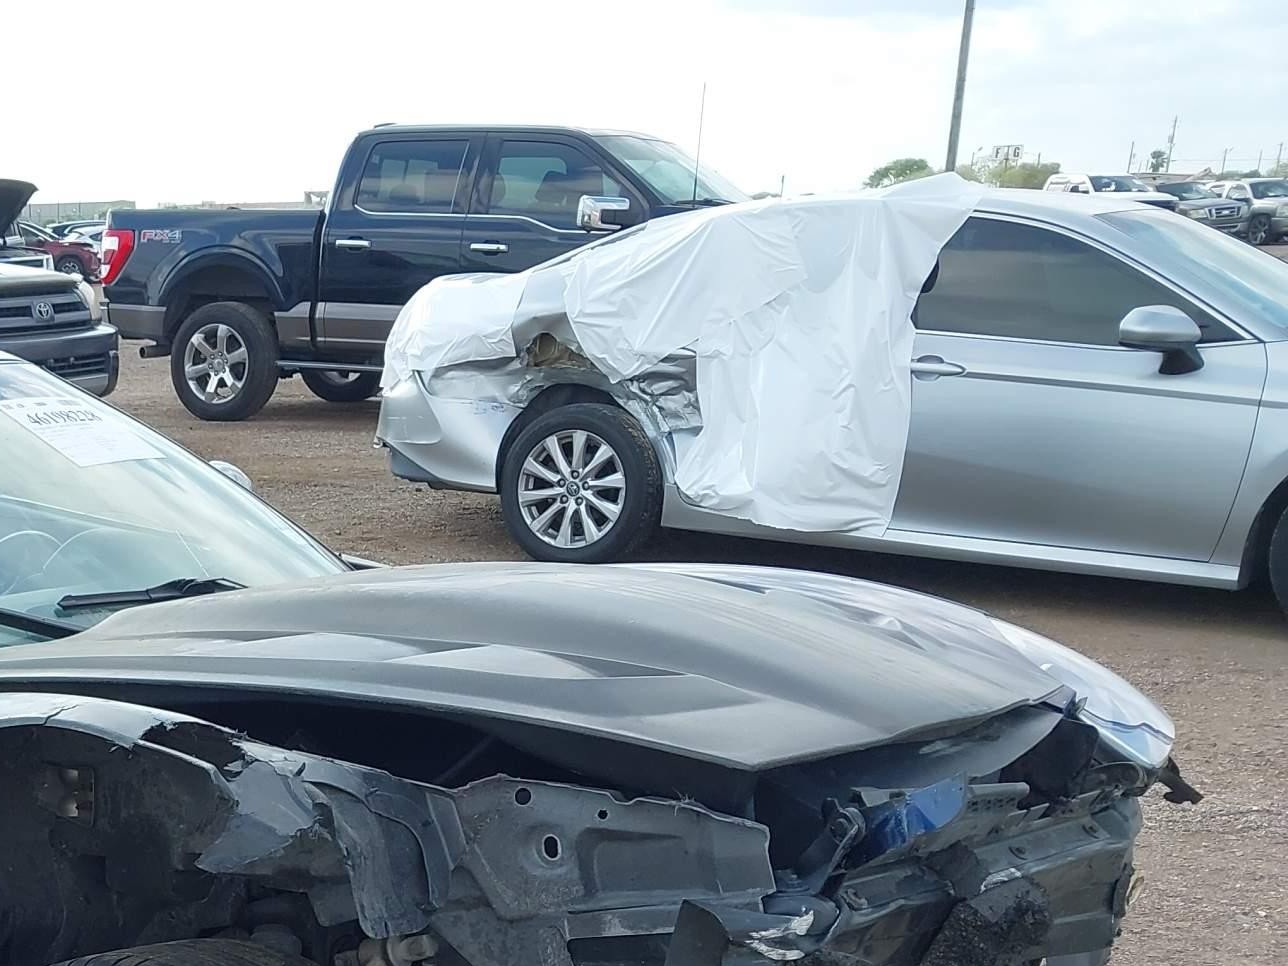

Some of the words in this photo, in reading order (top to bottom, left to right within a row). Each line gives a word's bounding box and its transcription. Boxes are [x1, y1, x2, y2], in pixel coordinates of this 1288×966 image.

[1013, 146, 1021, 158] G
[141, 229, 182, 243] FX4
[25, 410, 103, 425] 46198228
